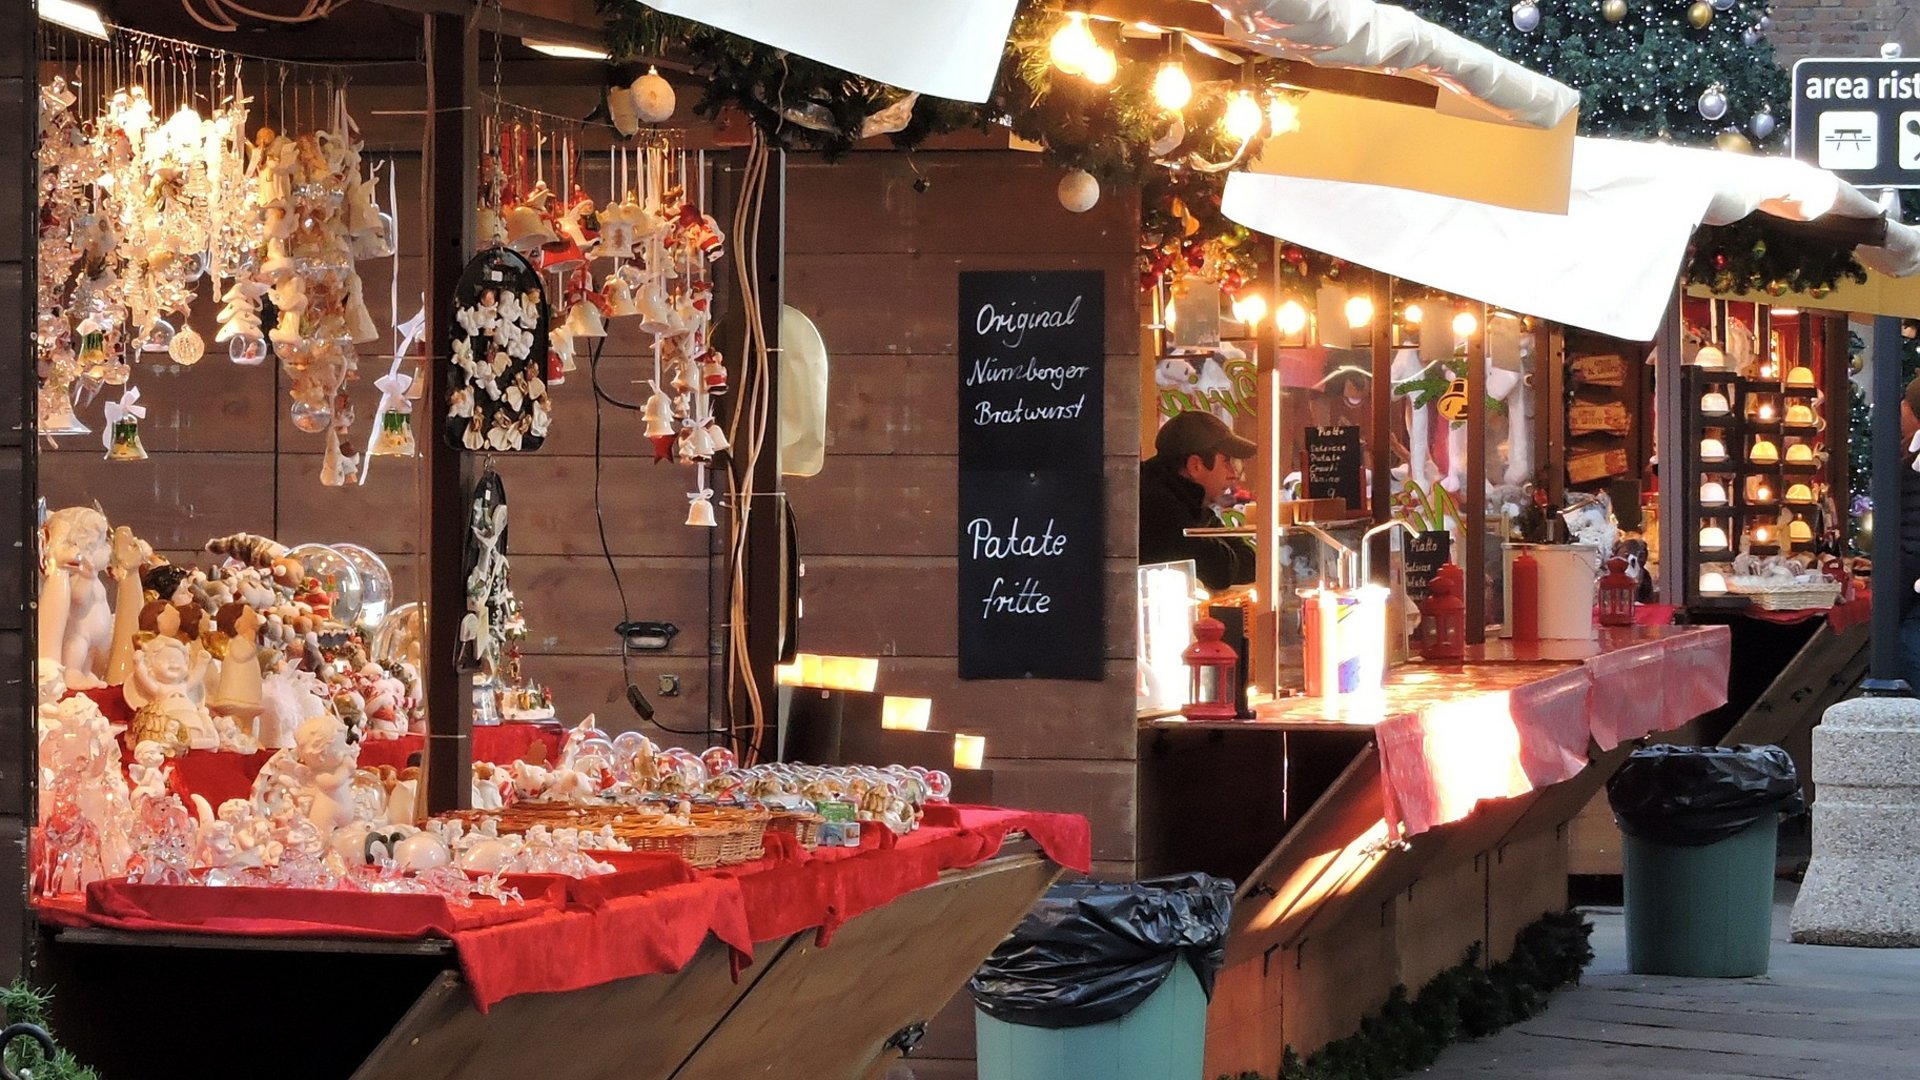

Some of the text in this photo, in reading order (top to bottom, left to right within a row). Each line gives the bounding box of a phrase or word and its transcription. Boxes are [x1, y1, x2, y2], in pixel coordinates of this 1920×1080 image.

[1805, 77, 1869, 99] area
[976, 295, 1082, 348] Original
[974, 393, 1085, 425] Bratwurst
[967, 516, 1068, 560] Patate
[982, 577, 1052, 619] fritte
